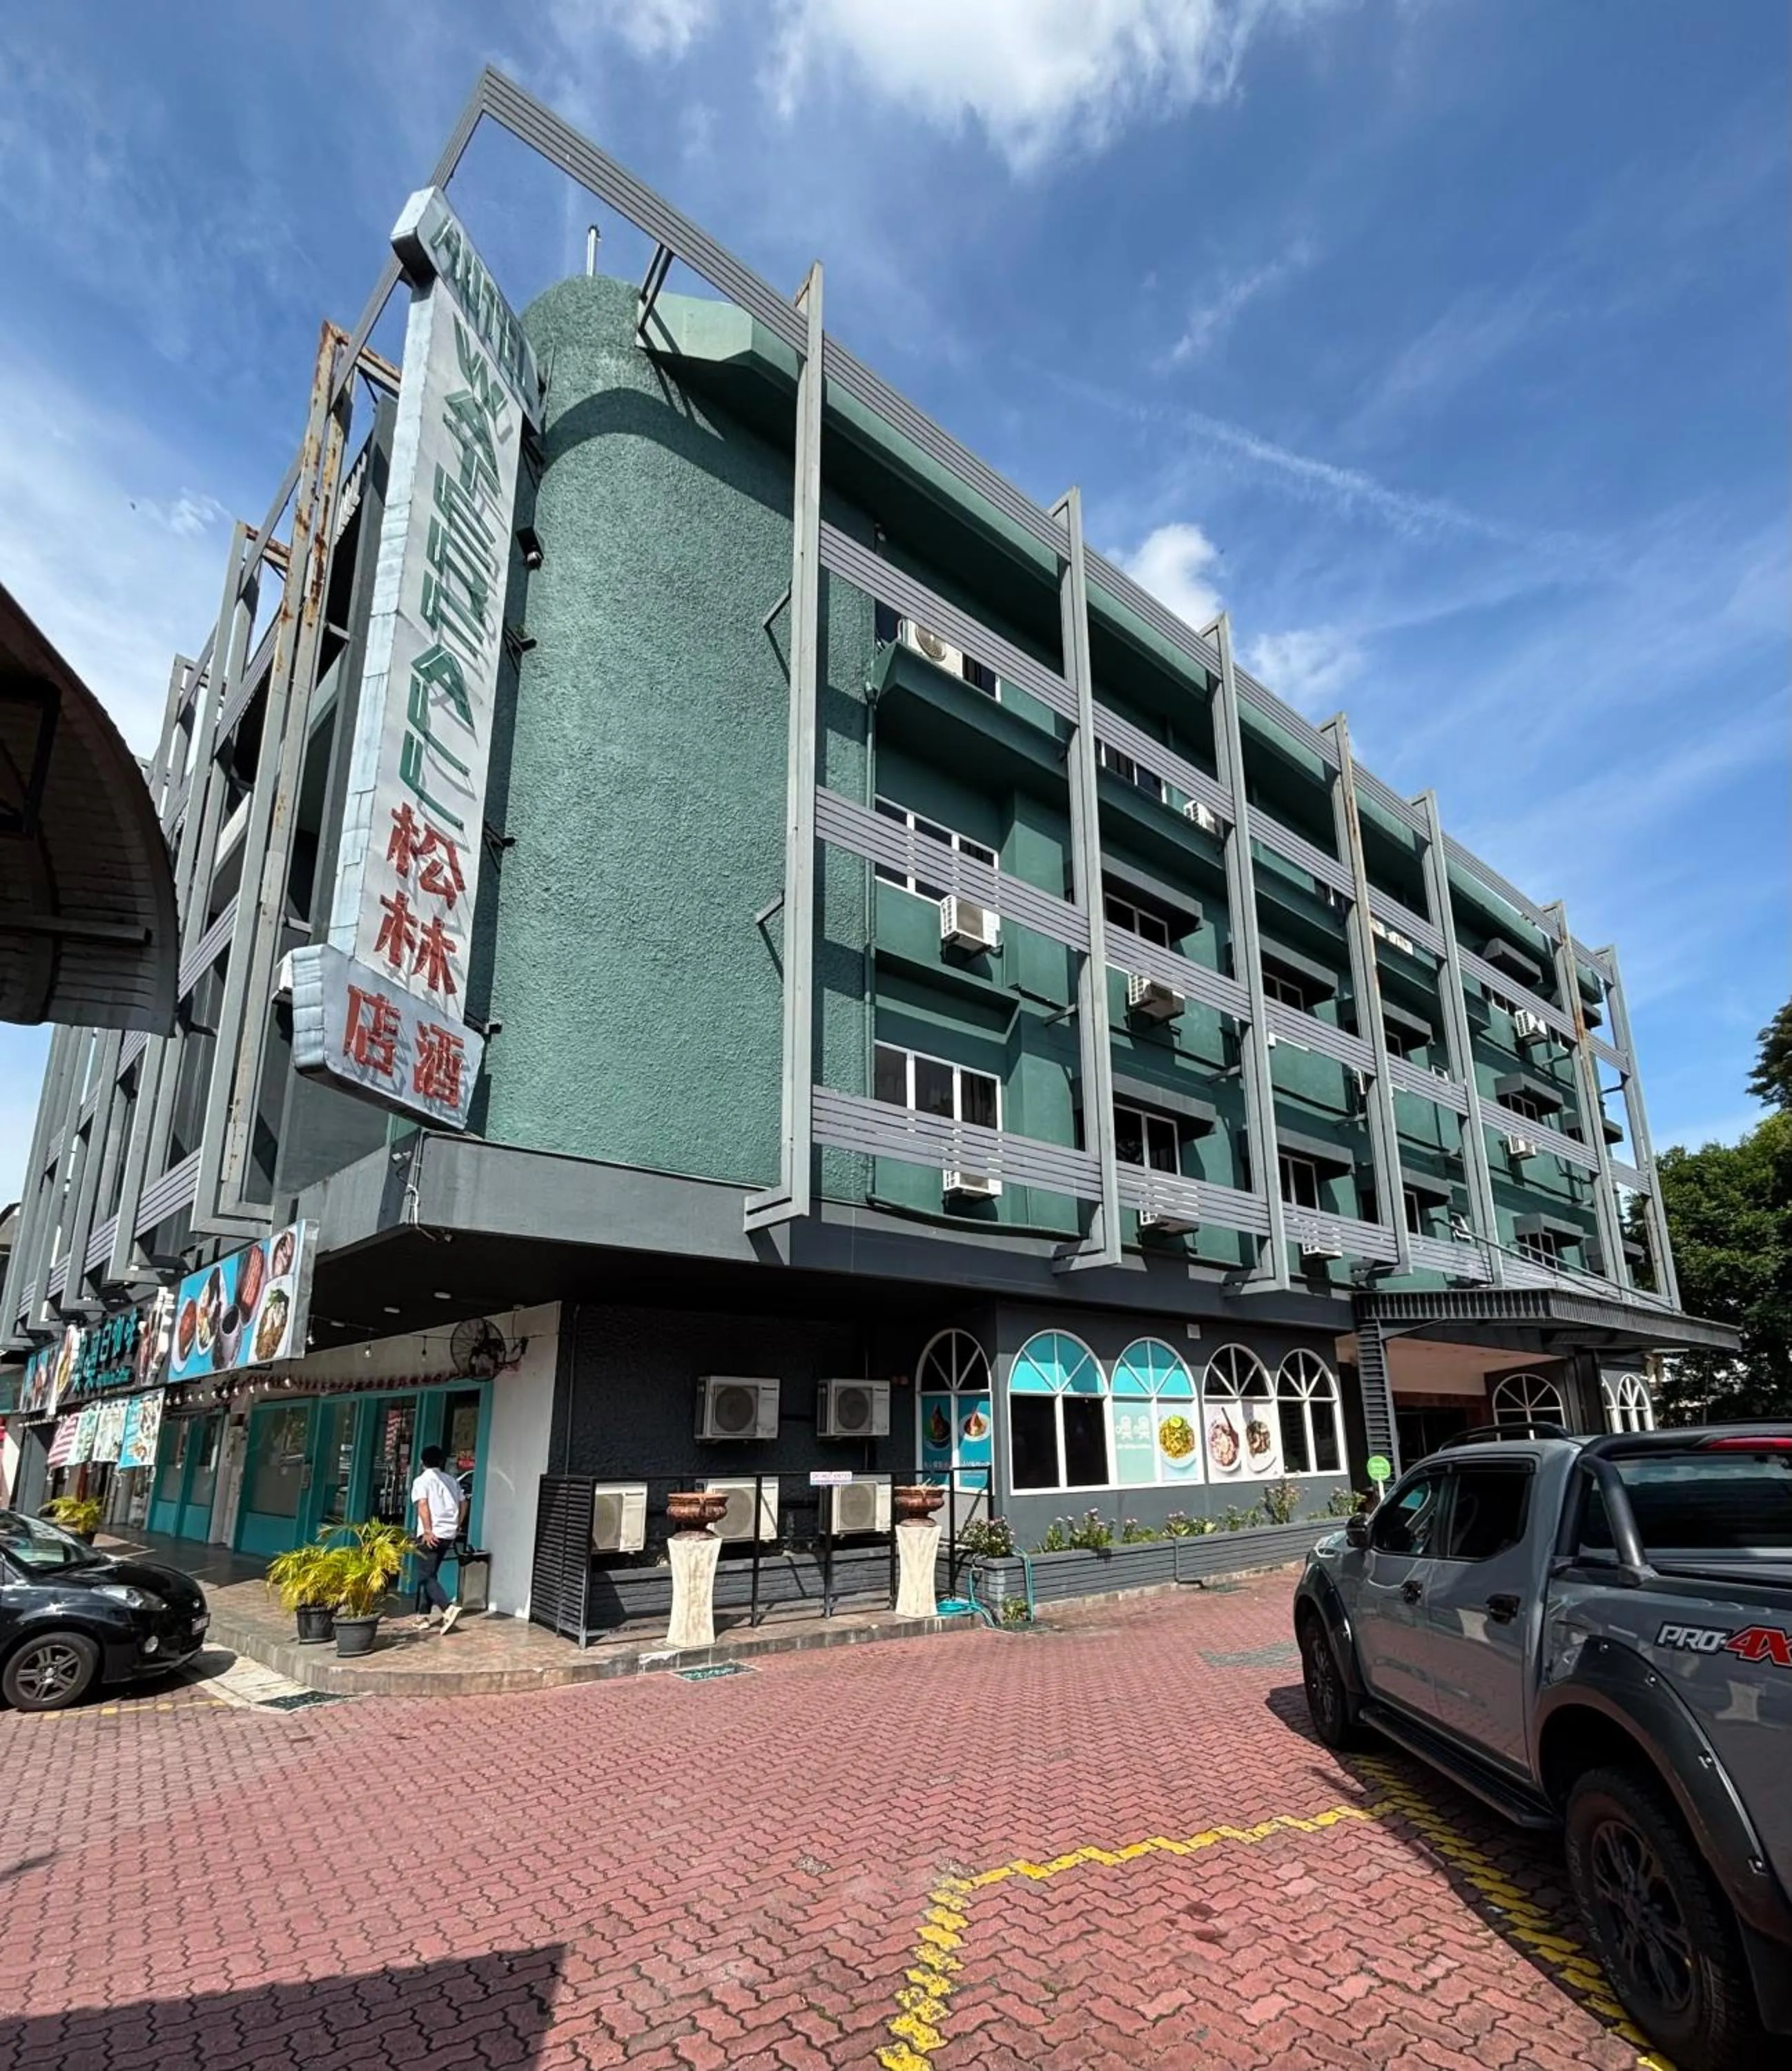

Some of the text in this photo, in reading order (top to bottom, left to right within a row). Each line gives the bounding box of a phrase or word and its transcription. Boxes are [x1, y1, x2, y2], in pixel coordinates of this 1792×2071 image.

[431, 218, 534, 412] HOTEL
[399, 311, 508, 831] WATERFALL
[375, 801, 467, 995] 松林
